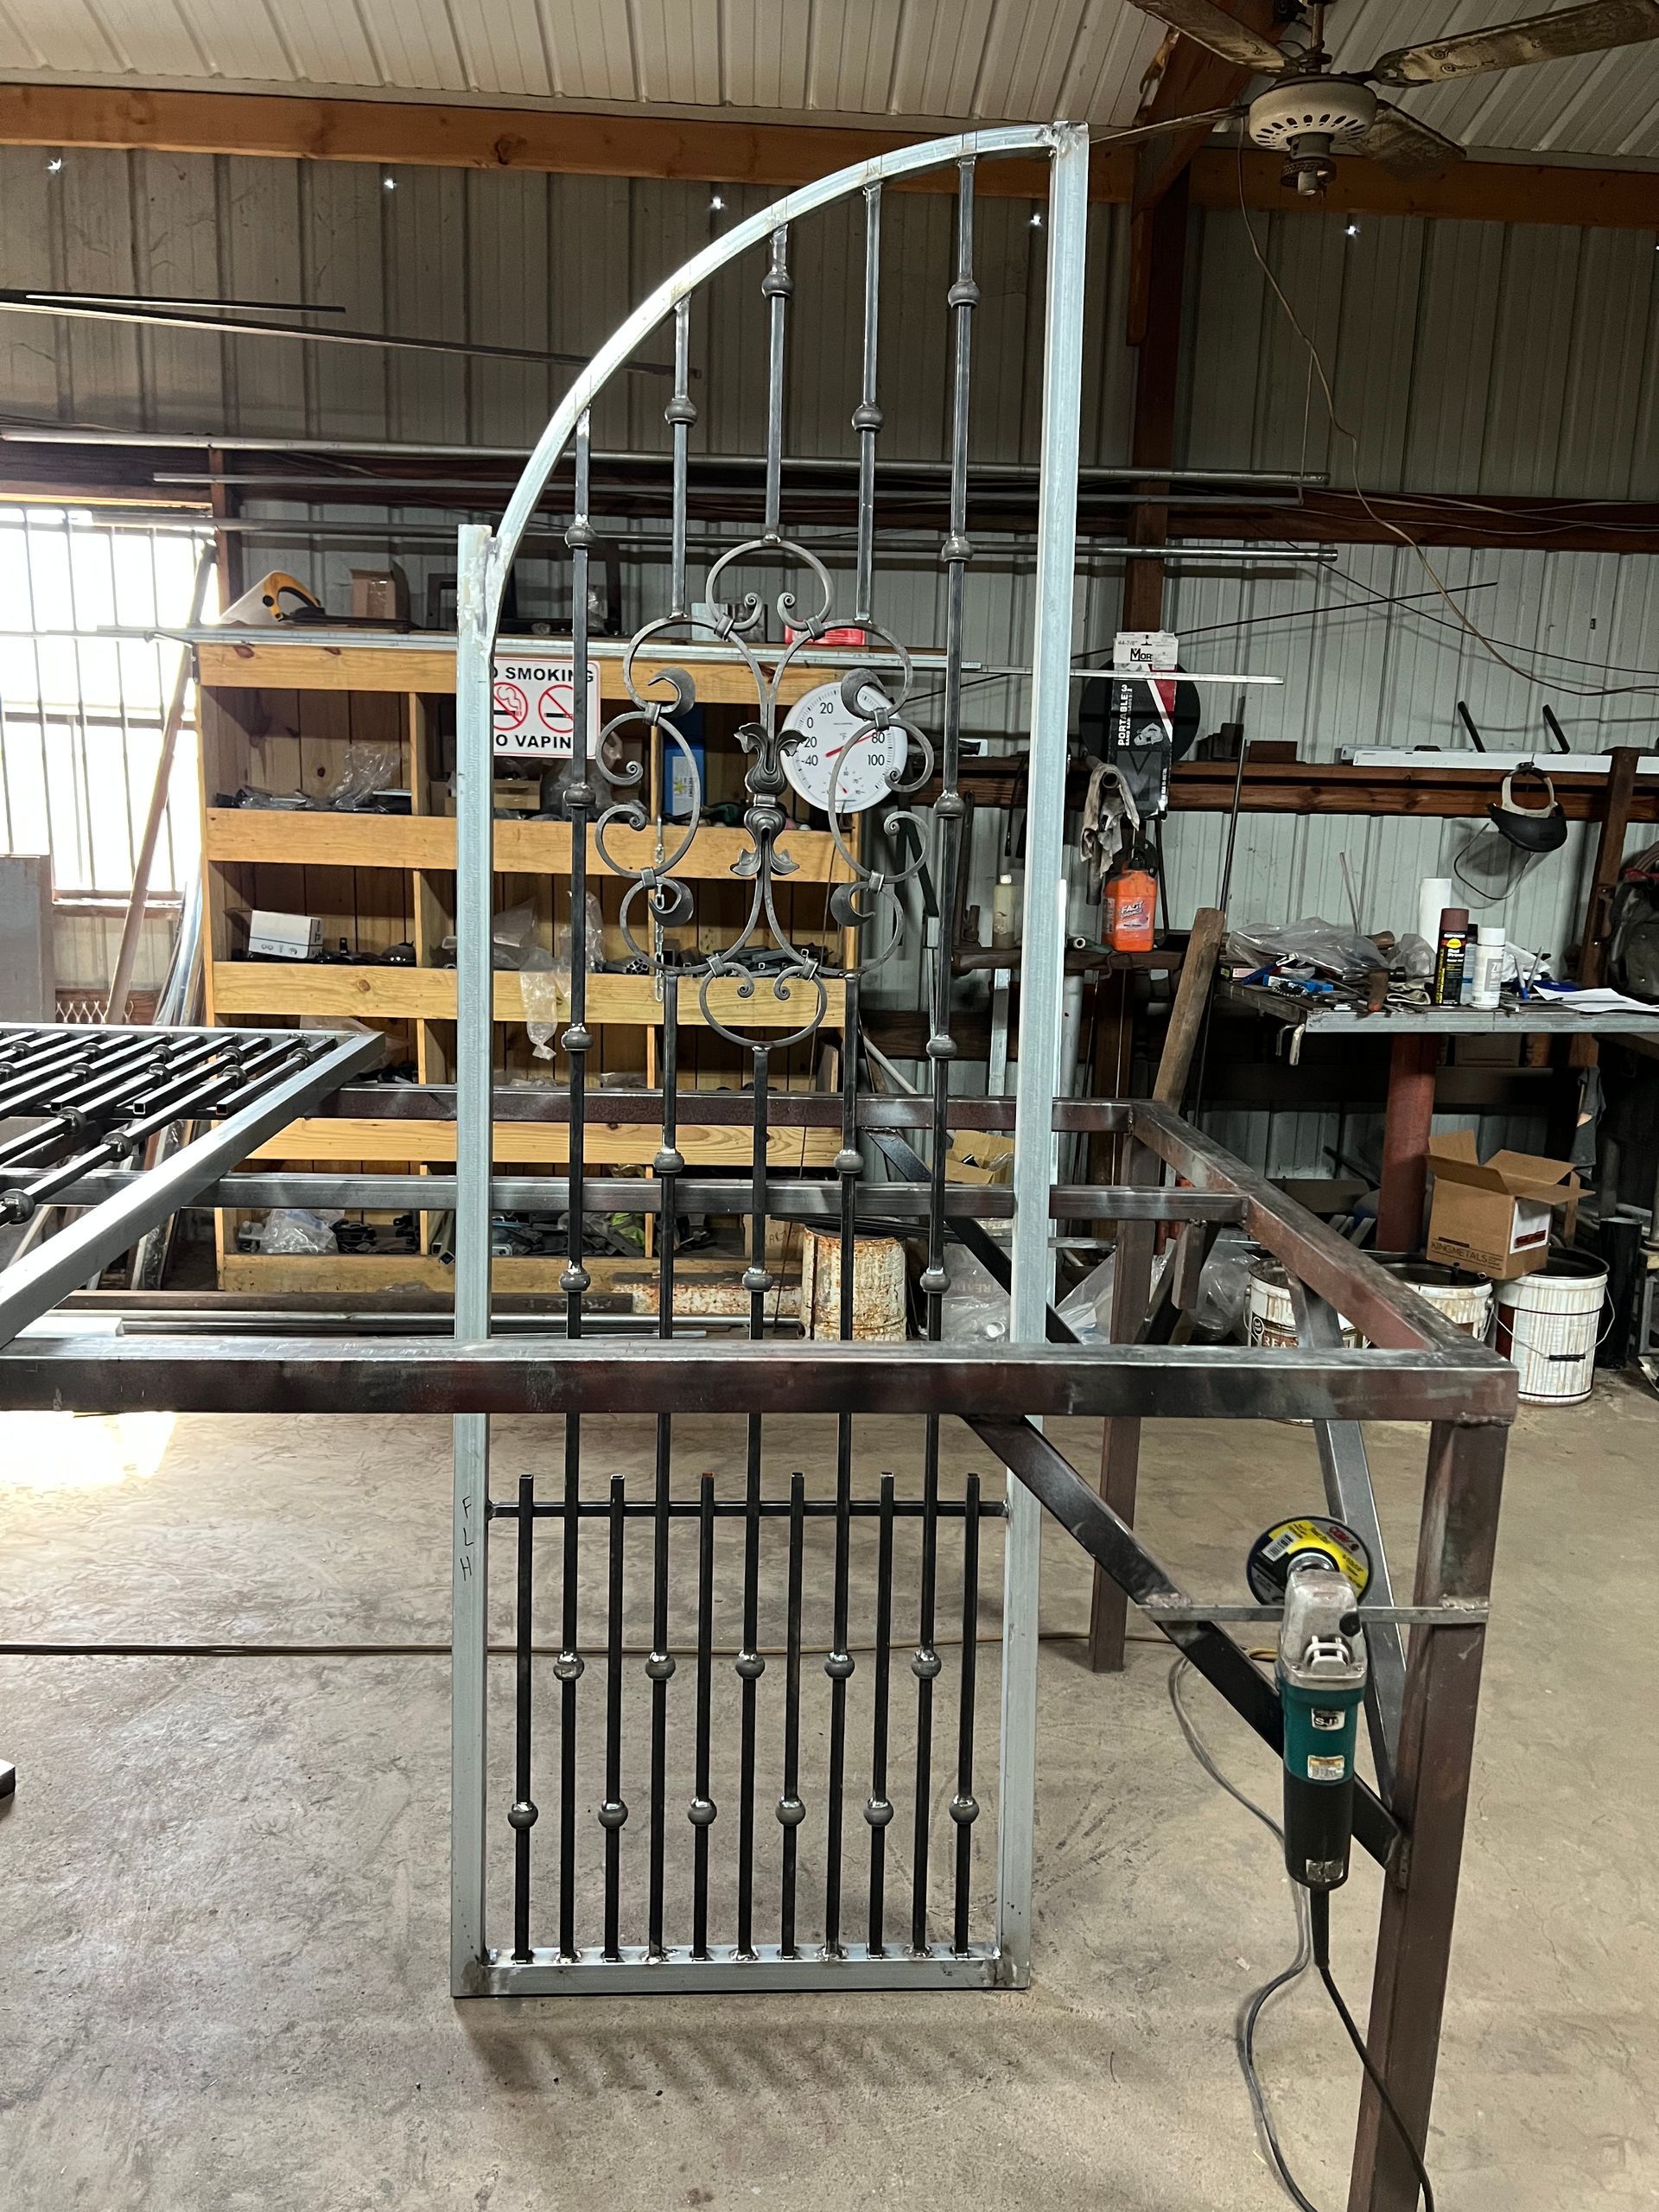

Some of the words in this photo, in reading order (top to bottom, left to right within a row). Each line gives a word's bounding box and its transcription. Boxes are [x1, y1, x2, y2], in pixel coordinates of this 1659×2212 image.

[1130, 648, 1154, 662] MOR
[820, 702, 834, 714] 20
[806, 717, 814, 728] 0
[1117, 692, 1128, 747] PORTABLE
[495, 734, 508, 747] O
[515, 734, 572, 749] VAPIN
[871, 733, 885, 744] 80
[801, 755, 818, 766] -40
[868, 754, 885, 766] 100
